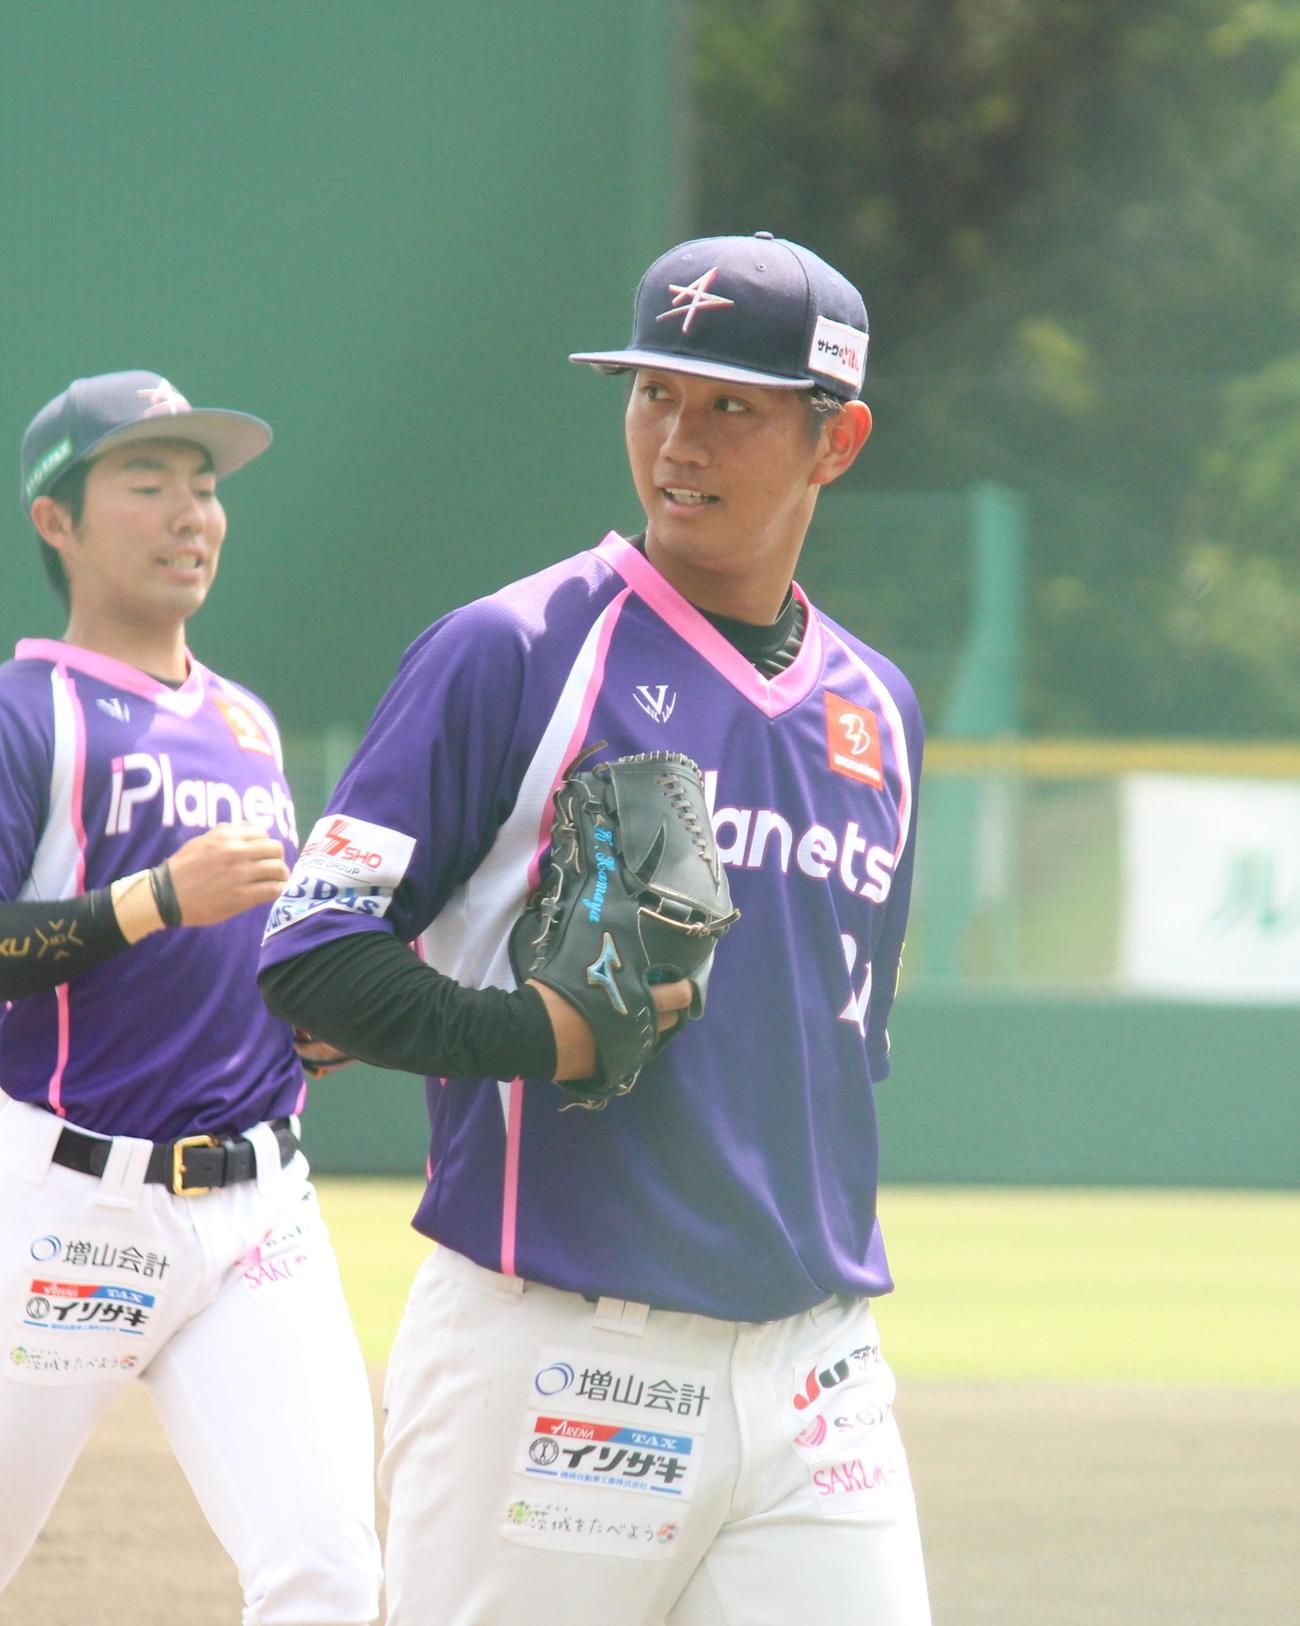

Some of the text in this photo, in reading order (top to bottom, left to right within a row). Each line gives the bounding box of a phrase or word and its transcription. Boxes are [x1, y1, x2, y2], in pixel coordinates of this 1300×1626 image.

[703, 771, 896, 903] lanets
[62, 1239, 170, 1280] 増山会計
[575, 1368, 710, 1417] 増山会計
[551, 1420, 677, 1449] ARENA TAX
